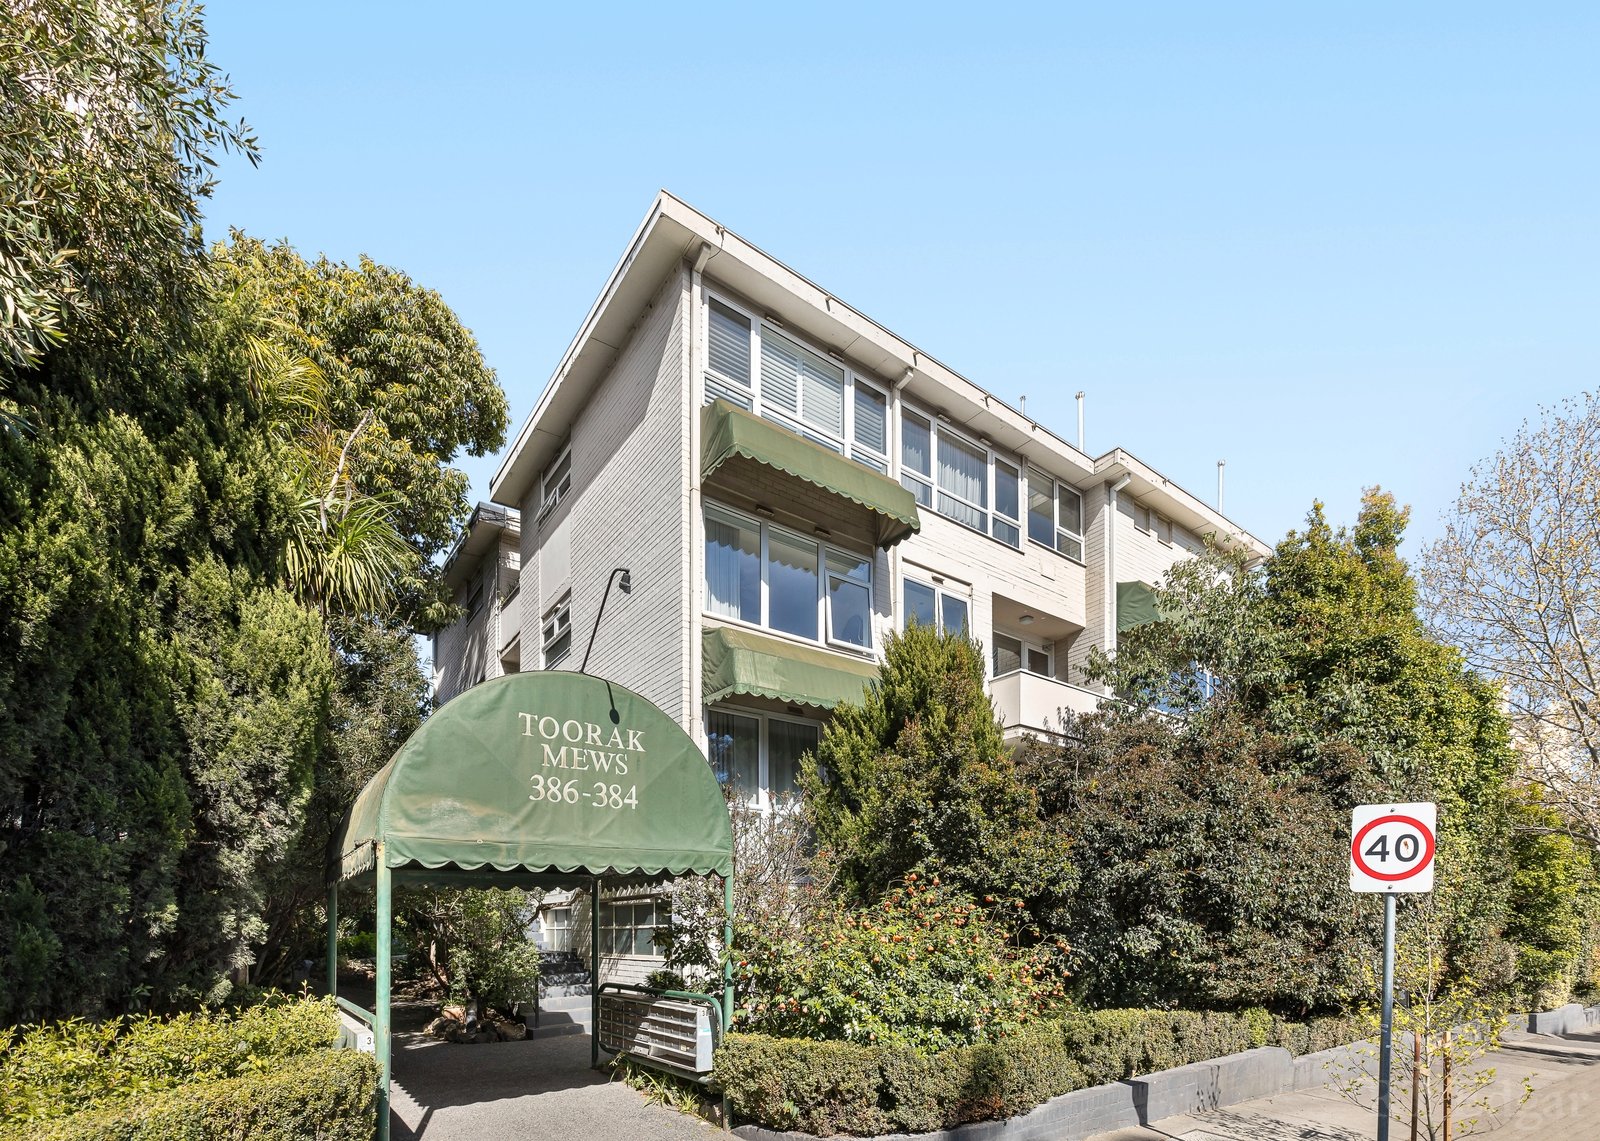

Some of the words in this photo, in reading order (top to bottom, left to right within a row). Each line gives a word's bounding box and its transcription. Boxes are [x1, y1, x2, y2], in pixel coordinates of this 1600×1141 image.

[518, 711, 647, 752] TOORAK
[540, 743, 628, 775] MEWS
[528, 774, 639, 810] 386-384
[1364, 833, 1420, 863] 40
